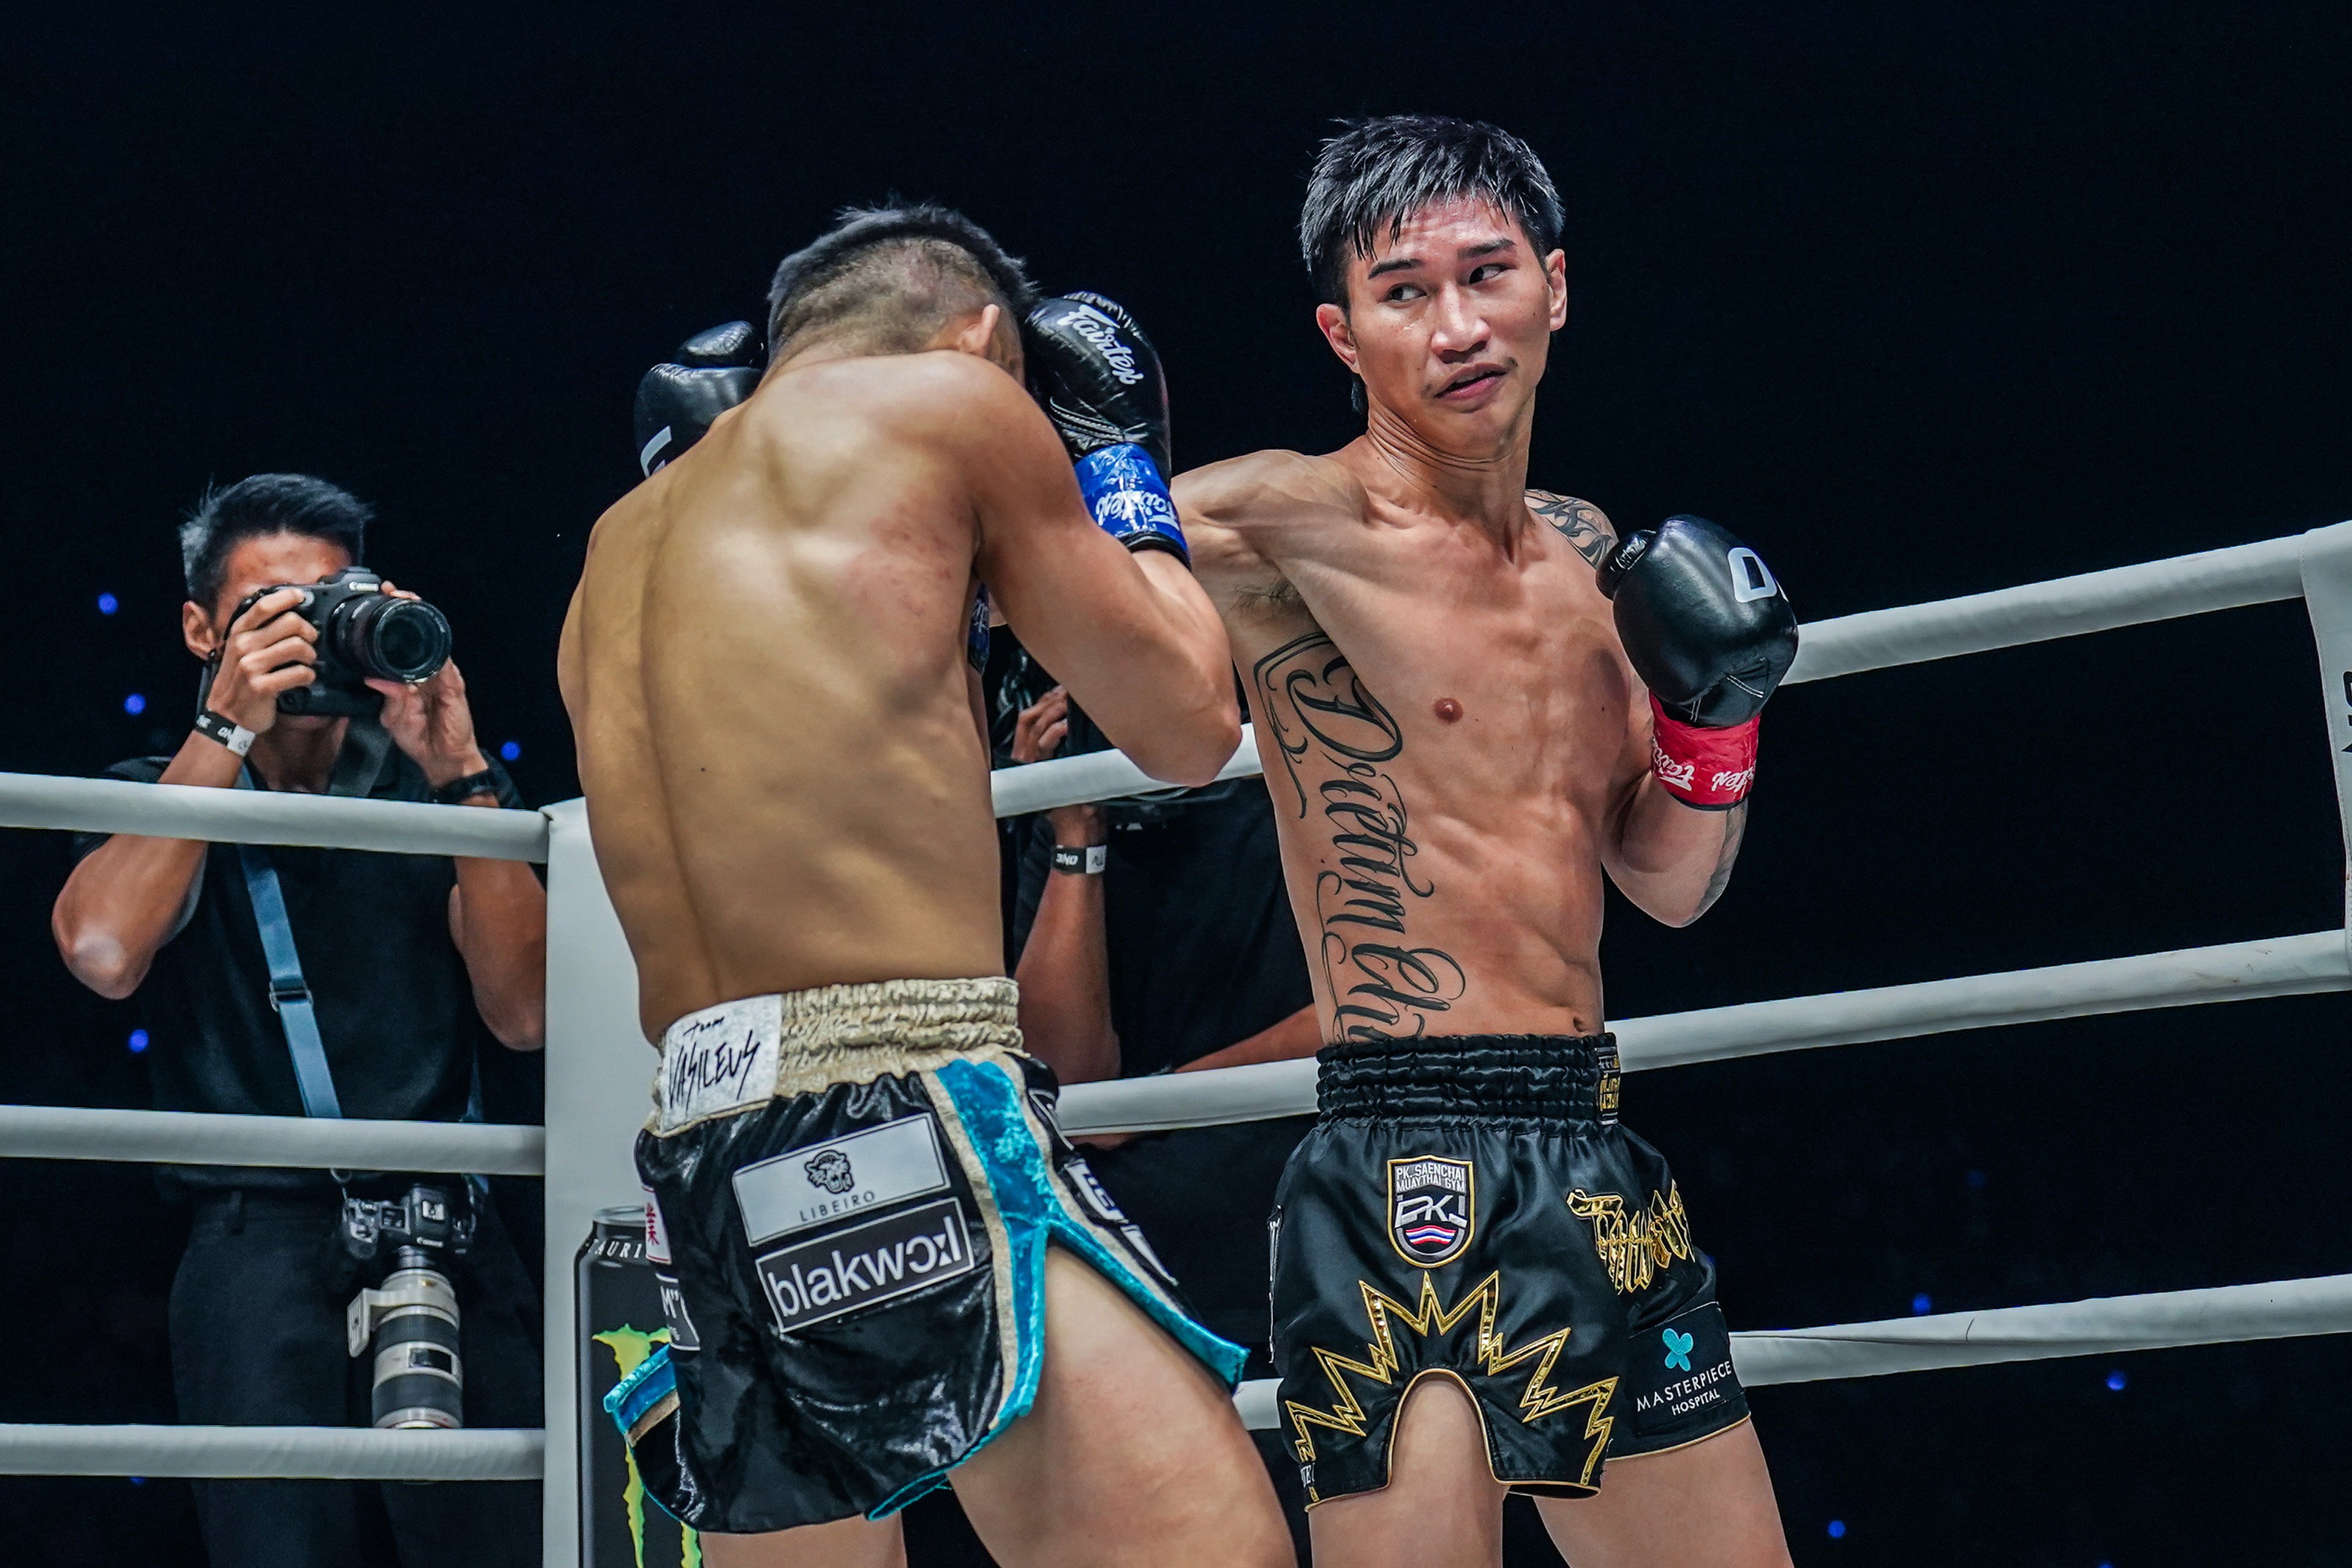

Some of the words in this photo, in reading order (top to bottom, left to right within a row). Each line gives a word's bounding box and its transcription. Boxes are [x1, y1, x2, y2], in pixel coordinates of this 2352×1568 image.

[1057, 304, 1144, 385] Fairtex
[1414, 1163, 1465, 1182] SAENCHAI
[1444, 1177, 1464, 1192] GYM
[799, 1190, 875, 1222] LIBEIRO
[1637, 1360, 1732, 1412] MASTERPIECE
[1671, 1388, 1721, 1416] HOSPITAL
